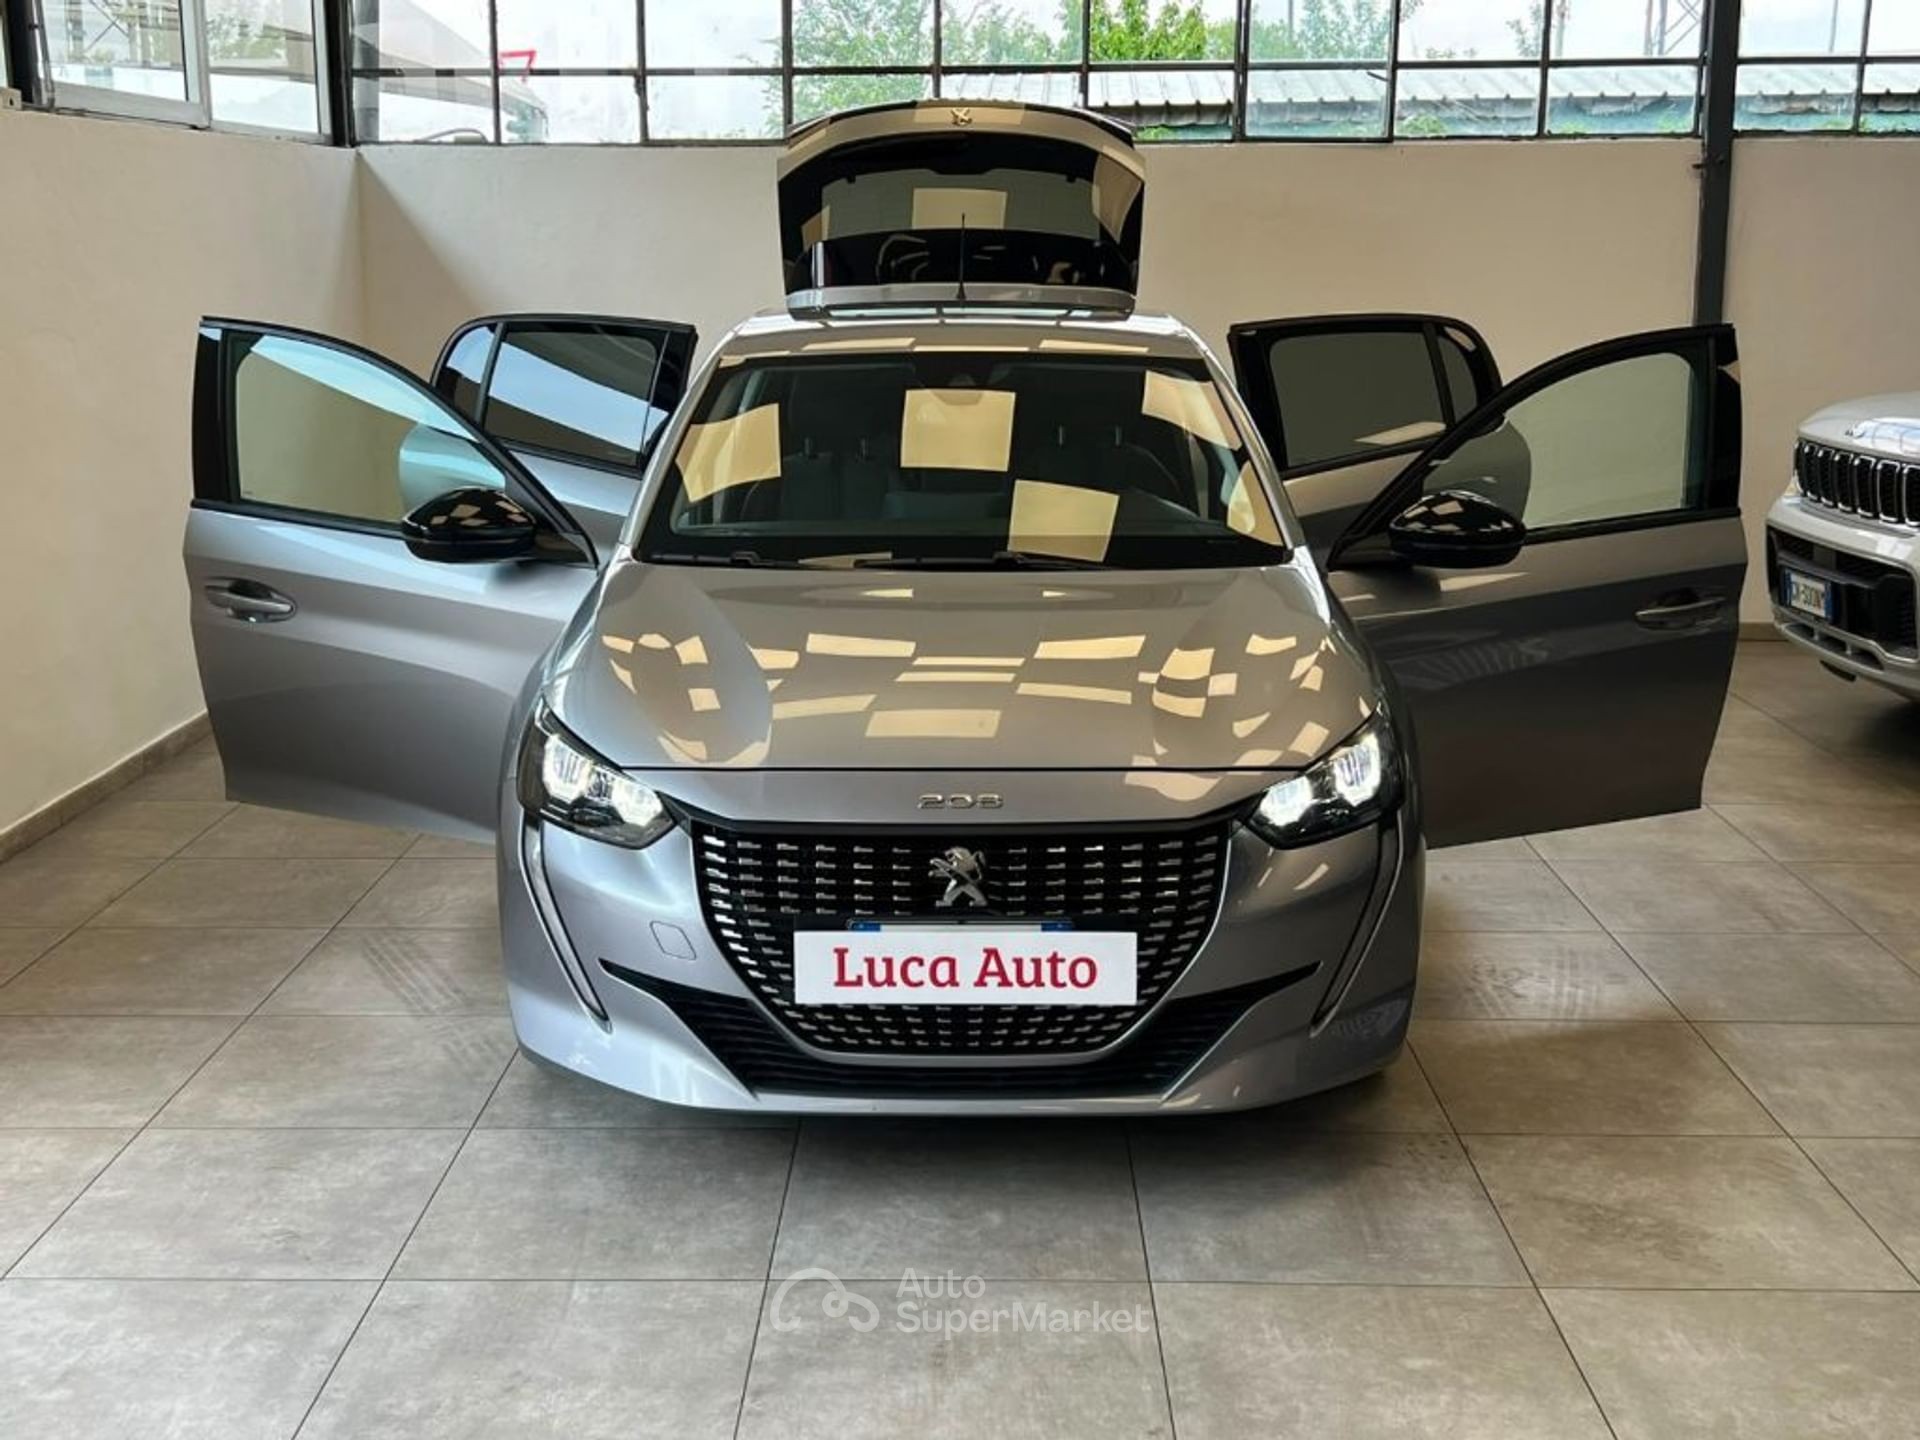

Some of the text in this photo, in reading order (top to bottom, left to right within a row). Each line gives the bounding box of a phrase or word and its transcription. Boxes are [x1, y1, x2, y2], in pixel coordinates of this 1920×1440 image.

[917, 794, 1003, 809] 208
[833, 947, 1098, 988] Luca Auto
